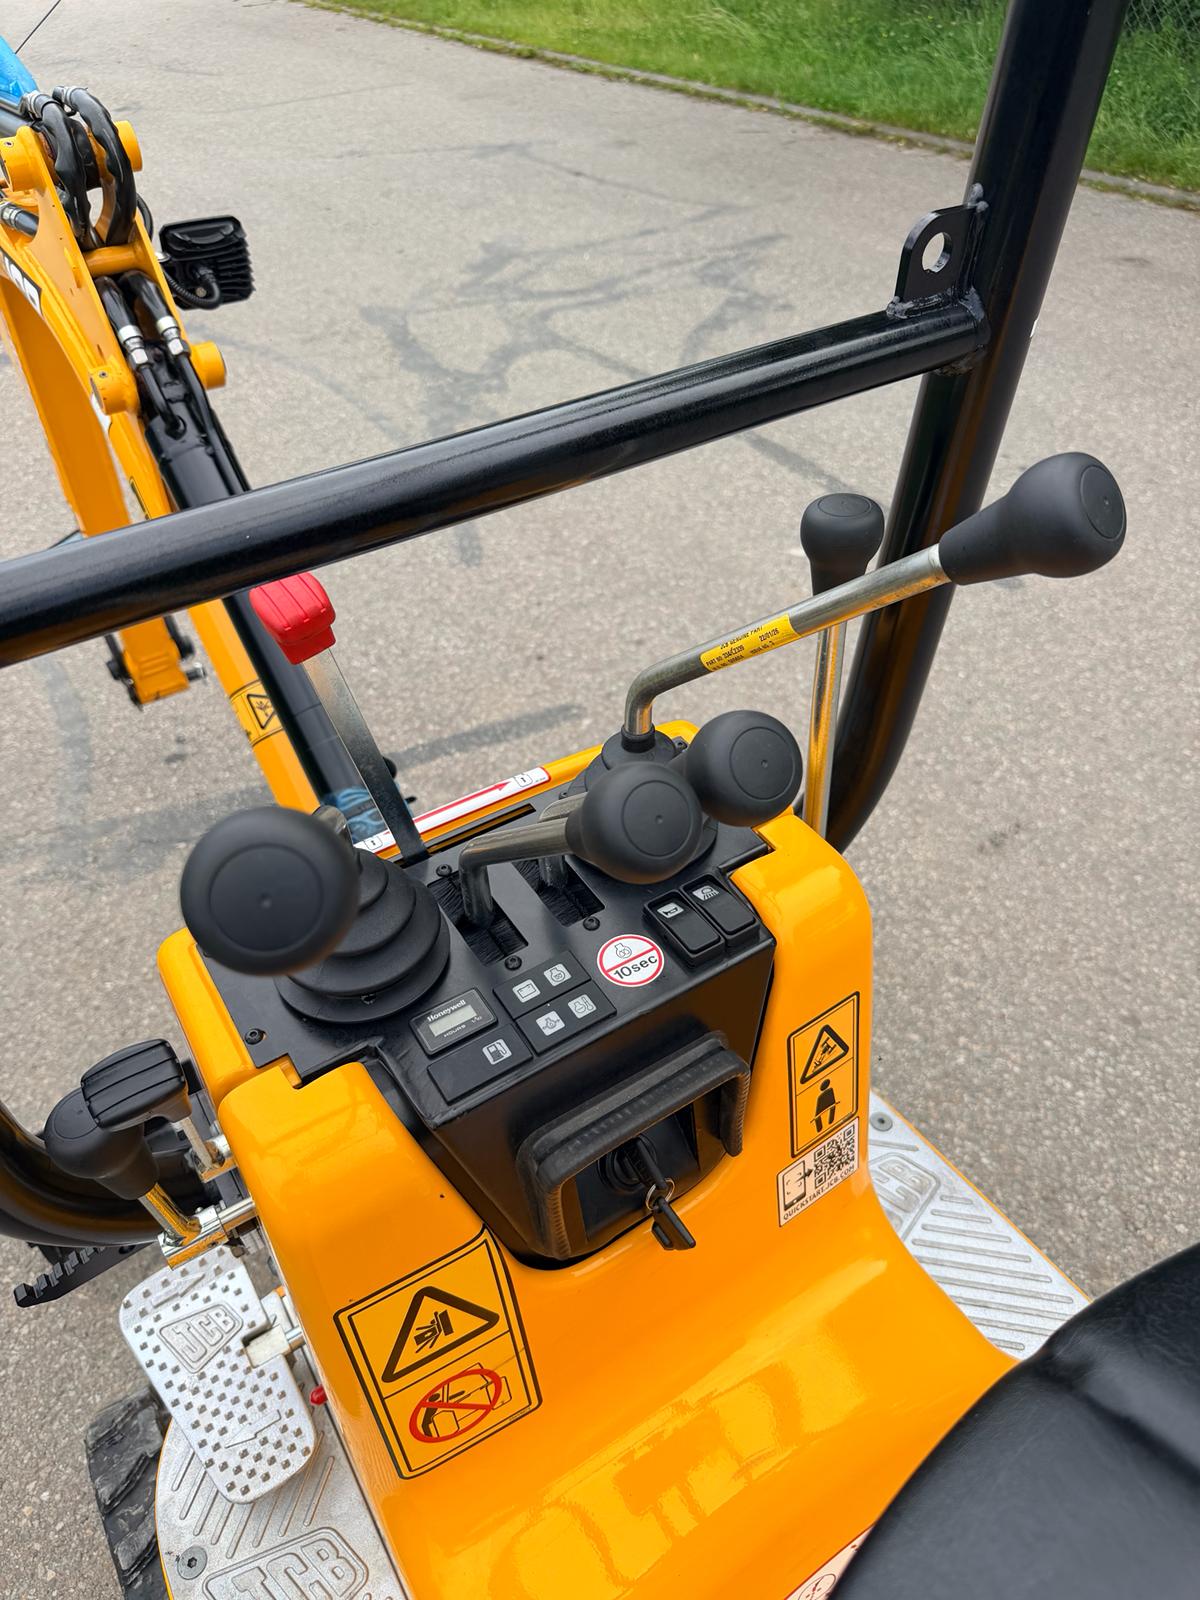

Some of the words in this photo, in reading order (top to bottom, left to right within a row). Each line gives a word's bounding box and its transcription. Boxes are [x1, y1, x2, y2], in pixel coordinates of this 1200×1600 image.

[613, 954, 658, 980] 10sec
[427, 999, 467, 1022] Honeywell
[783, 1164, 855, 1220] QUICKSTART.JCB.COM
[171, 1309, 236, 1363] JCB
